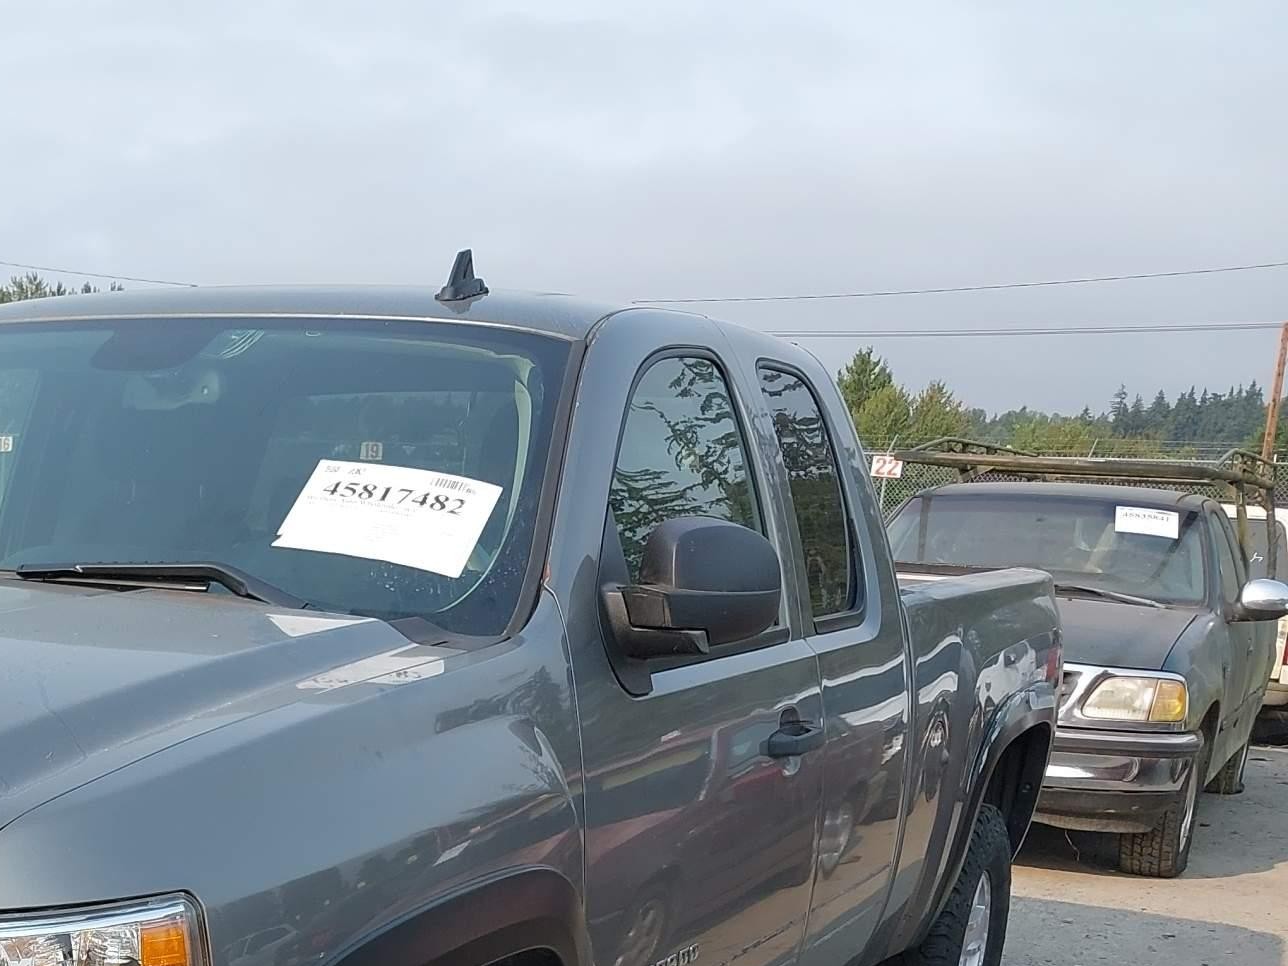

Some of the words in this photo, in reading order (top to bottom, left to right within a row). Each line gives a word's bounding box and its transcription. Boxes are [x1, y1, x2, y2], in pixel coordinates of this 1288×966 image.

[365, 443, 380, 458] 19
[874, 458, 900, 476] 22
[323, 480, 466, 516] 45817482
